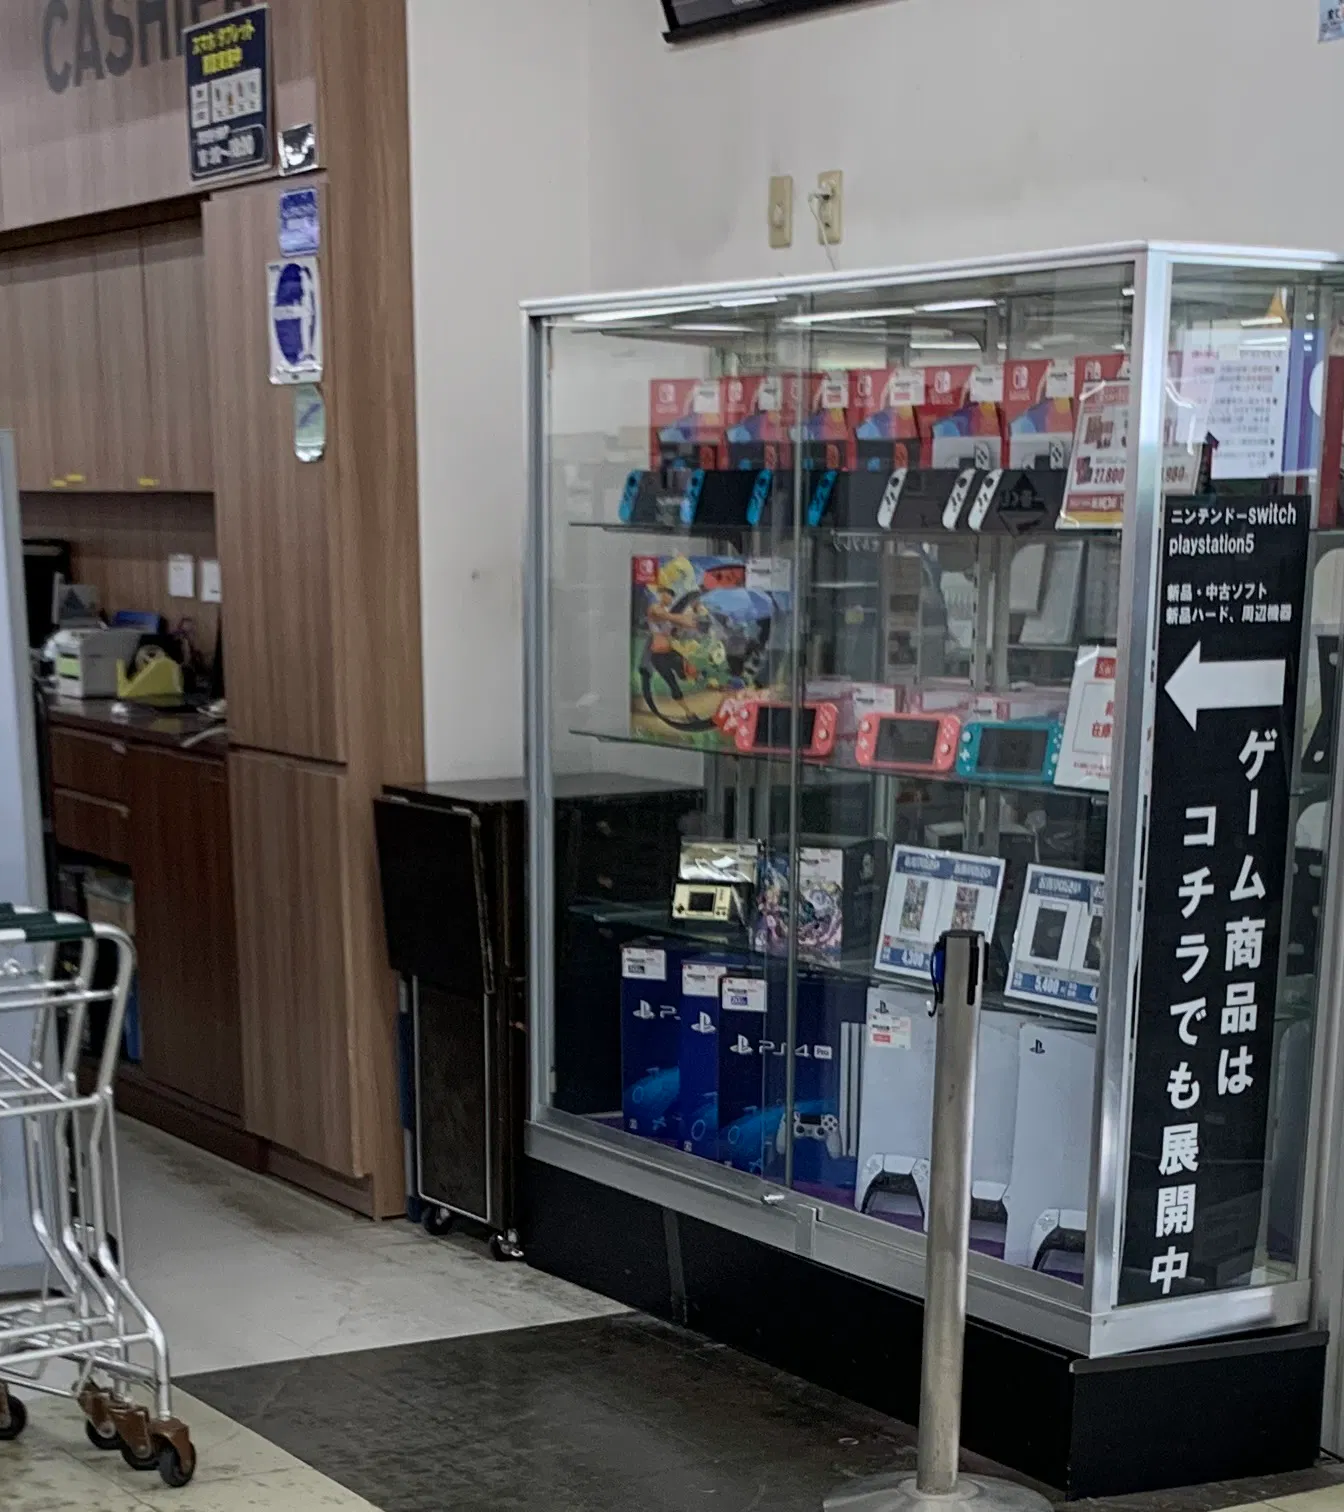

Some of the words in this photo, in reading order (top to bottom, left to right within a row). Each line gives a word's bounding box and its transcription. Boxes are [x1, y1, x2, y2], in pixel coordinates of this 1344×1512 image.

[42, 0, 204, 94] CASHI
[1171, 502, 1297, 526] ニンテンドーswitch
[1168, 533, 1255, 558] playstation5
[1167, 581, 1268, 603] 新品・中古ソフト
[1166, 603, 1292, 625] 新品ハード、周辺機器
[1217, 728, 1278, 1096] ゲーム商品は
[1149, 806, 1217, 1295] コチラでも展開中
